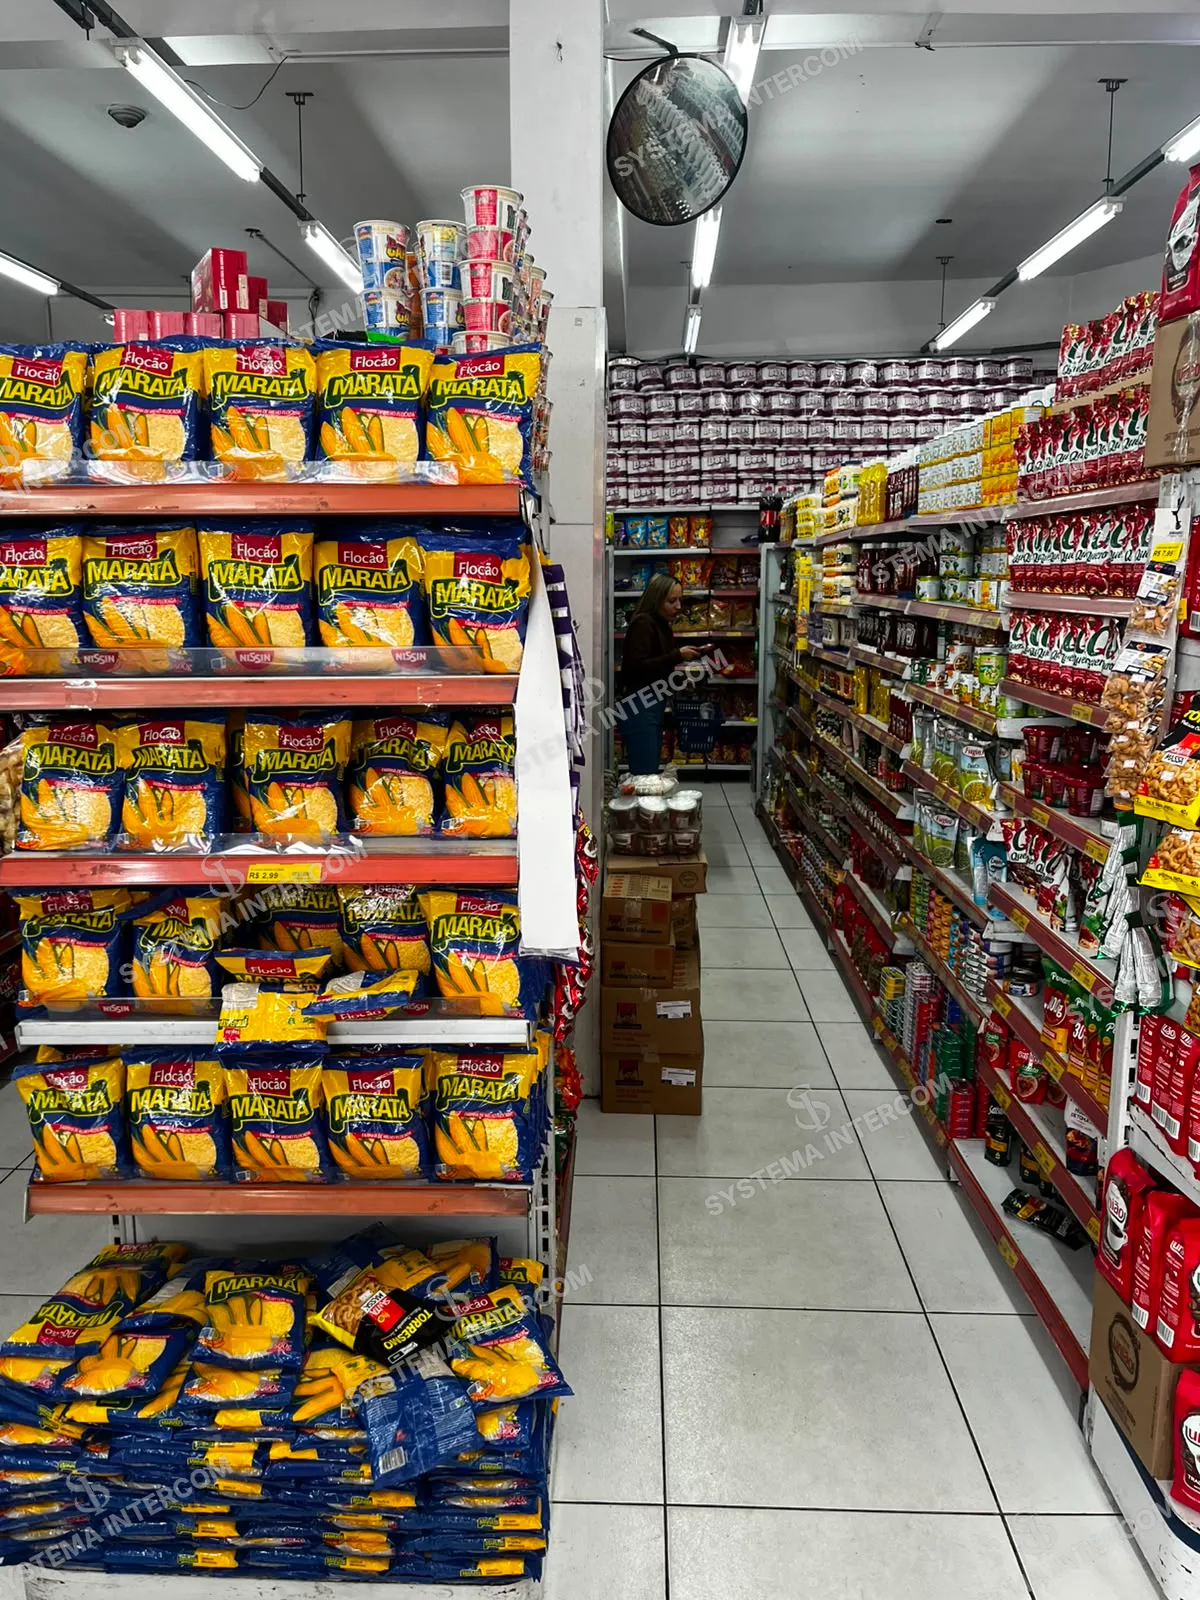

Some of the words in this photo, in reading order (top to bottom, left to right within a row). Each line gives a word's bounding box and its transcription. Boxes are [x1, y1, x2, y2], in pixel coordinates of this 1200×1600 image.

[84, 655, 116, 664] NISSIN
[239, 653, 271, 663] NISSIN
[395, 652, 426, 661] NISSIN
[262, 872, 279, 880] 2,99
[103, 1004, 130, 1013] NISSIN
[383, 1309, 433, 1350] TORRESMO
